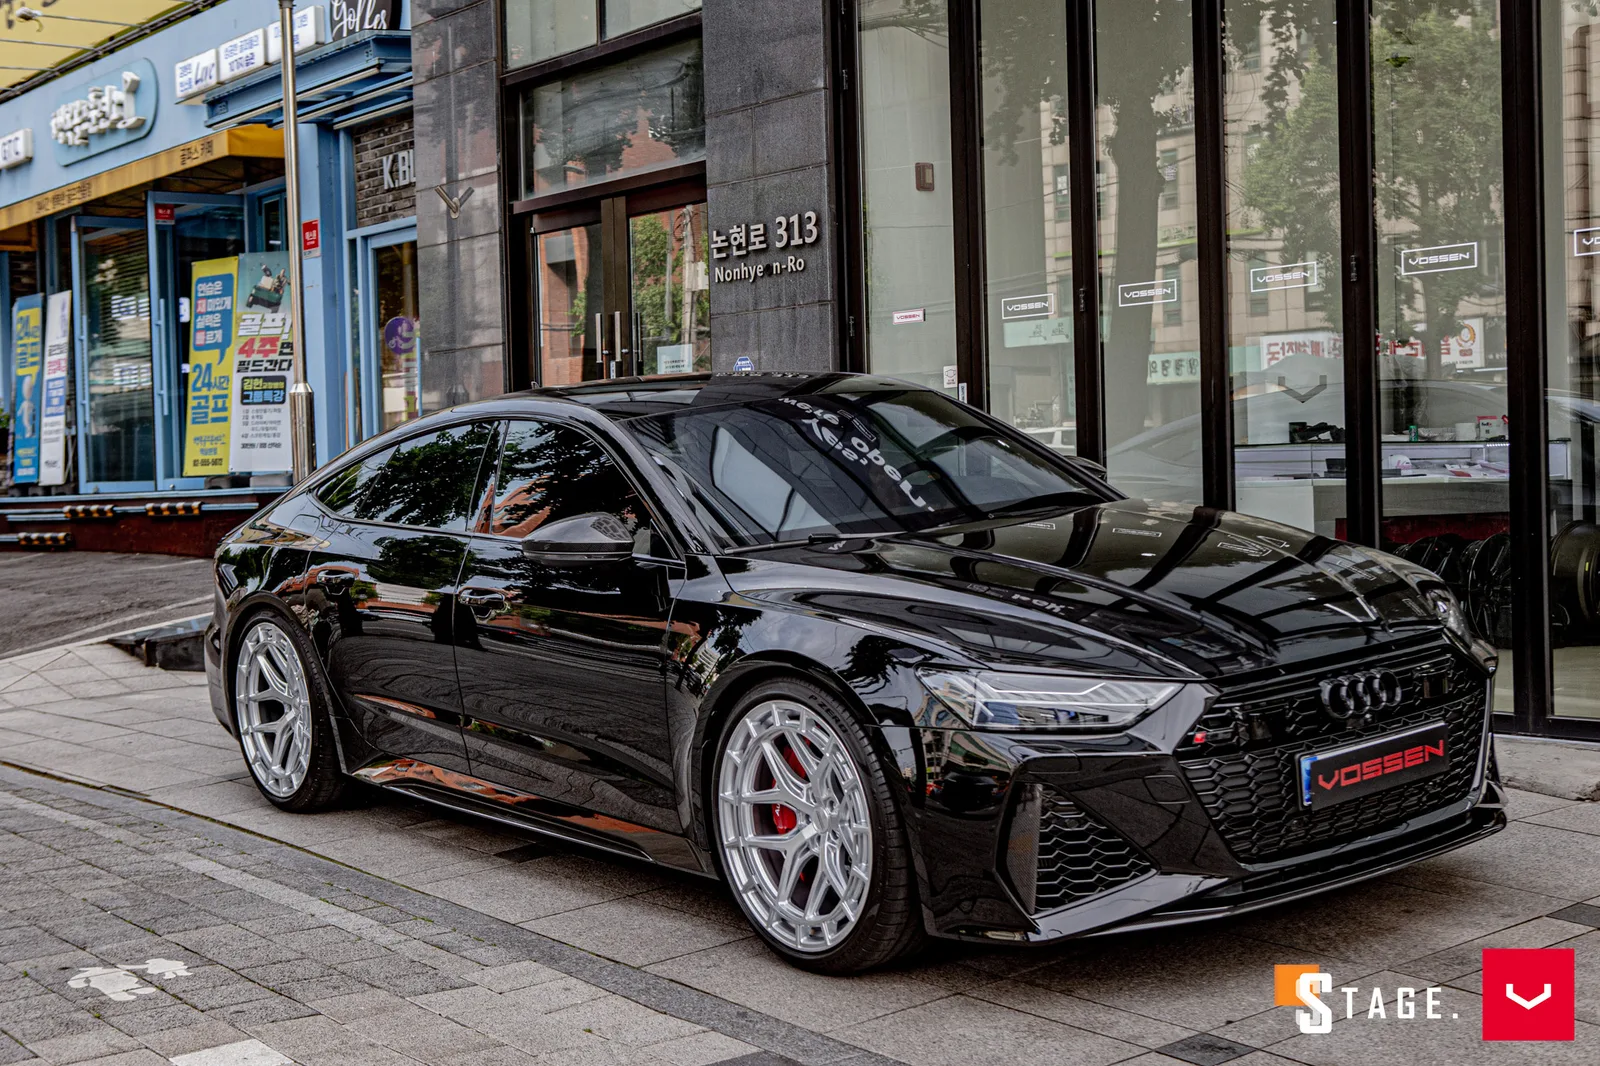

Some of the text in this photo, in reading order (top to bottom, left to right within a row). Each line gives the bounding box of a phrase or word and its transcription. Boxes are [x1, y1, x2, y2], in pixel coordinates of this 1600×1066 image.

[711, 211, 818, 259] 논현로 313
[1409, 252, 1470, 266] VOSSEN
[1257, 271, 1311, 283] VOSSEN
[197, 281, 223, 296] 연습은
[1124, 288, 1172, 299] VOSSEN
[1007, 301, 1049, 312] VOSSEN
[238, 312, 292, 340] 골프!
[238, 336, 294, 358] 4주면
[236, 359, 292, 373] 필드간다
[191, 393, 229, 425] 골프
[1317, 739, 1445, 790] VOSSEN
